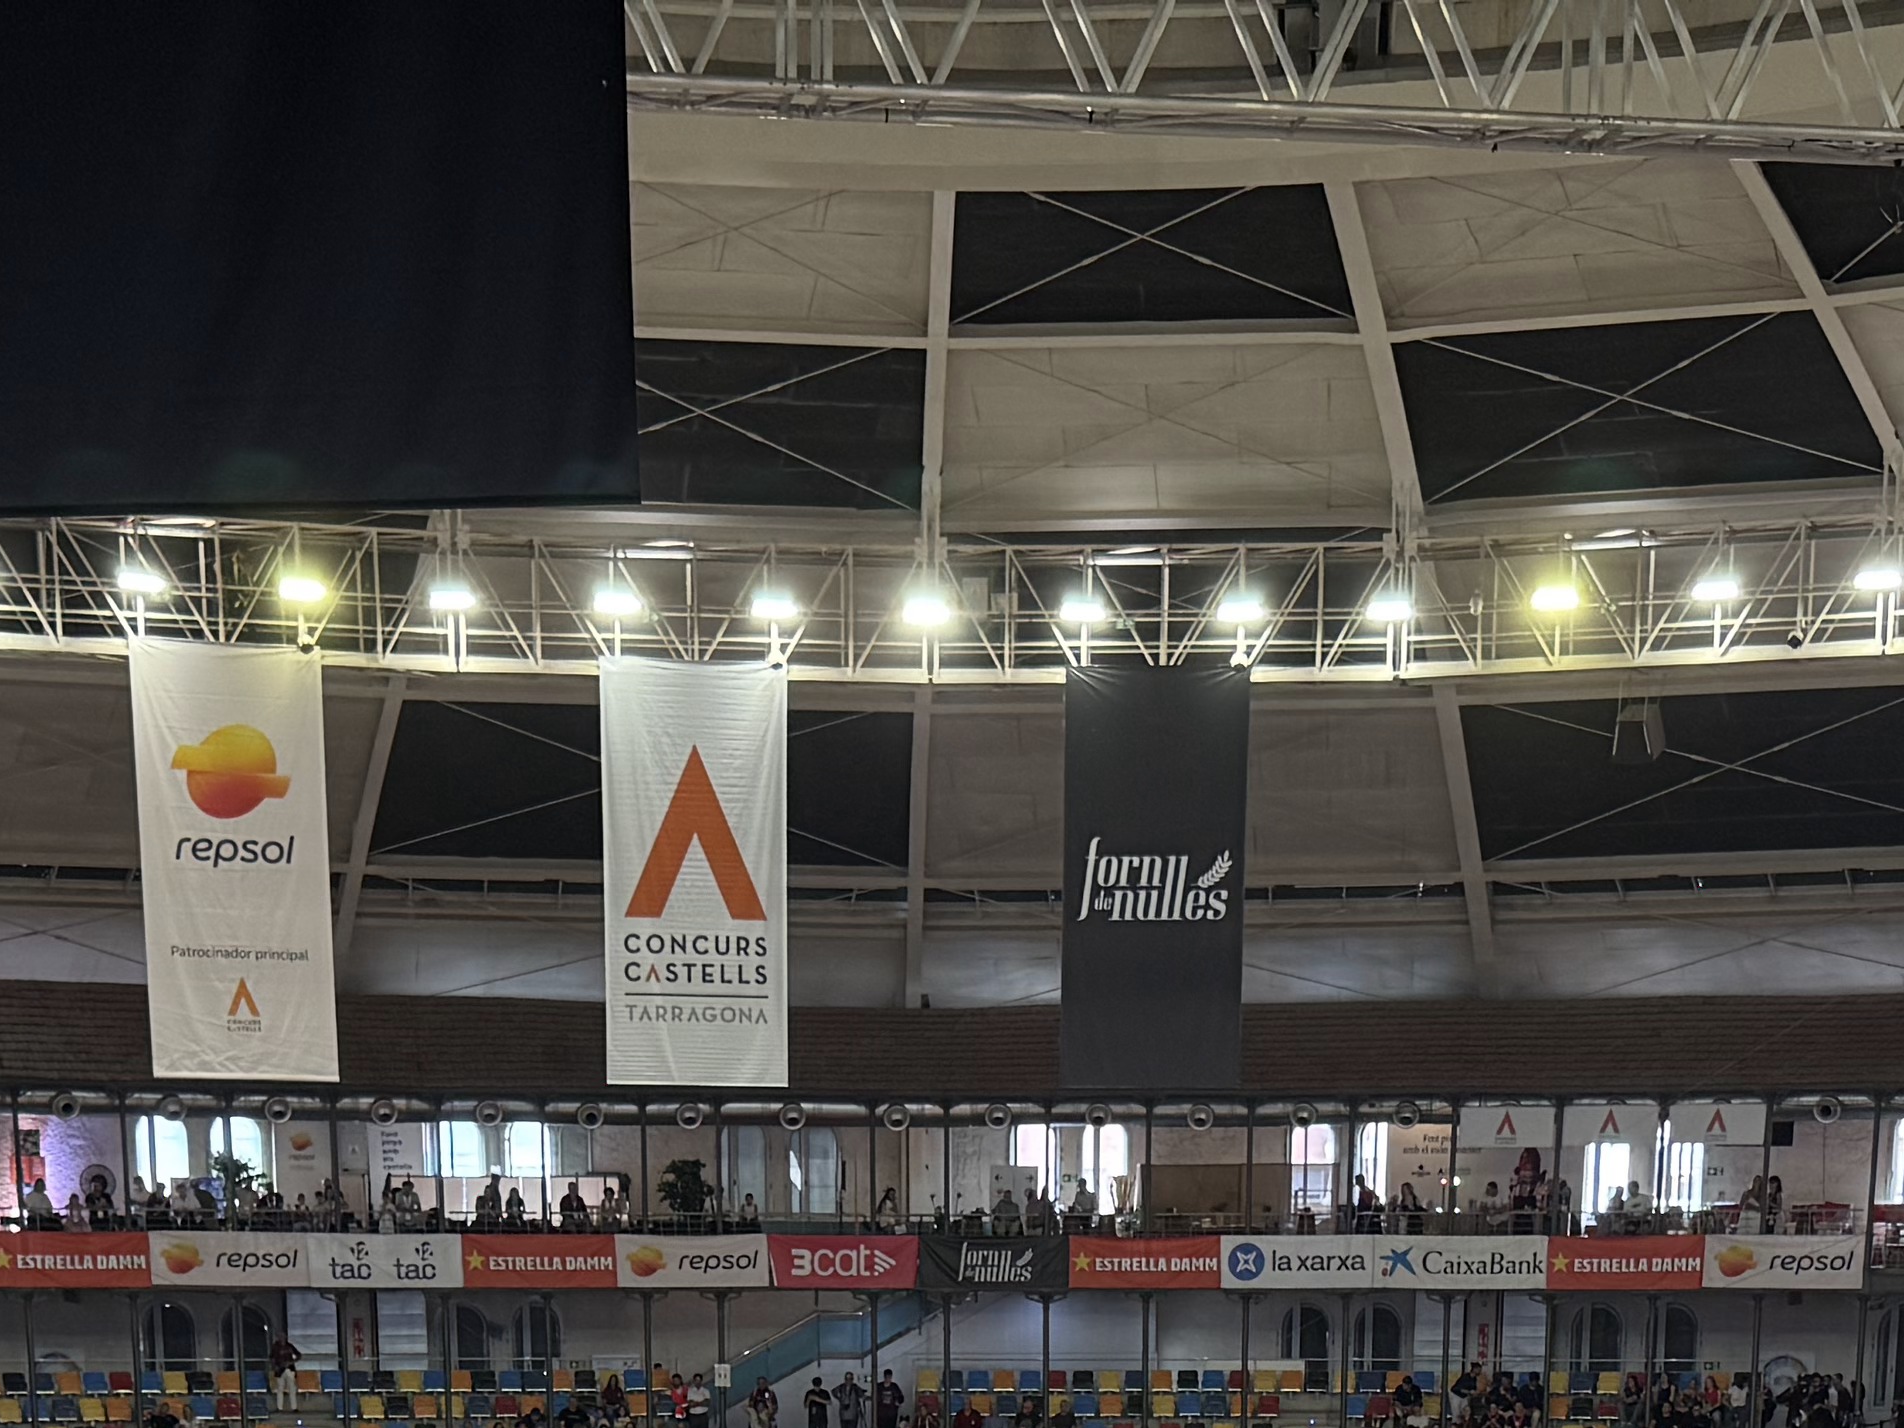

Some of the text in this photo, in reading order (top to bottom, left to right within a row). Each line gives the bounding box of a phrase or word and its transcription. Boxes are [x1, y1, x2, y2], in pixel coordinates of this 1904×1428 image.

[174, 834, 295, 869] repsol
[170, 945, 309, 963] Patrocinador principal
[624, 932, 768, 956] CONCURS
[624, 961, 768, 985] CASTELLS
[625, 1004, 769, 1025] TARRAGONA
[17, 1254, 146, 1270] ESTRELLA DAMM
[216, 1249, 299, 1272] repsol
[489, 1256, 613, 1271] ESTRELLA DAMM
[678, 1249, 758, 1273] repsol
[790, 1246, 871, 1276] 3cat
[1095, 1257, 1218, 1272] ESTRELLA DAMM
[1272, 1250, 1366, 1272] la xarxa
[1422, 1250, 1545, 1276] CaixaBank
[1573, 1257, 1700, 1273] ESTRELLA DAMM
[1768, 1251, 1854, 1273] repsol
